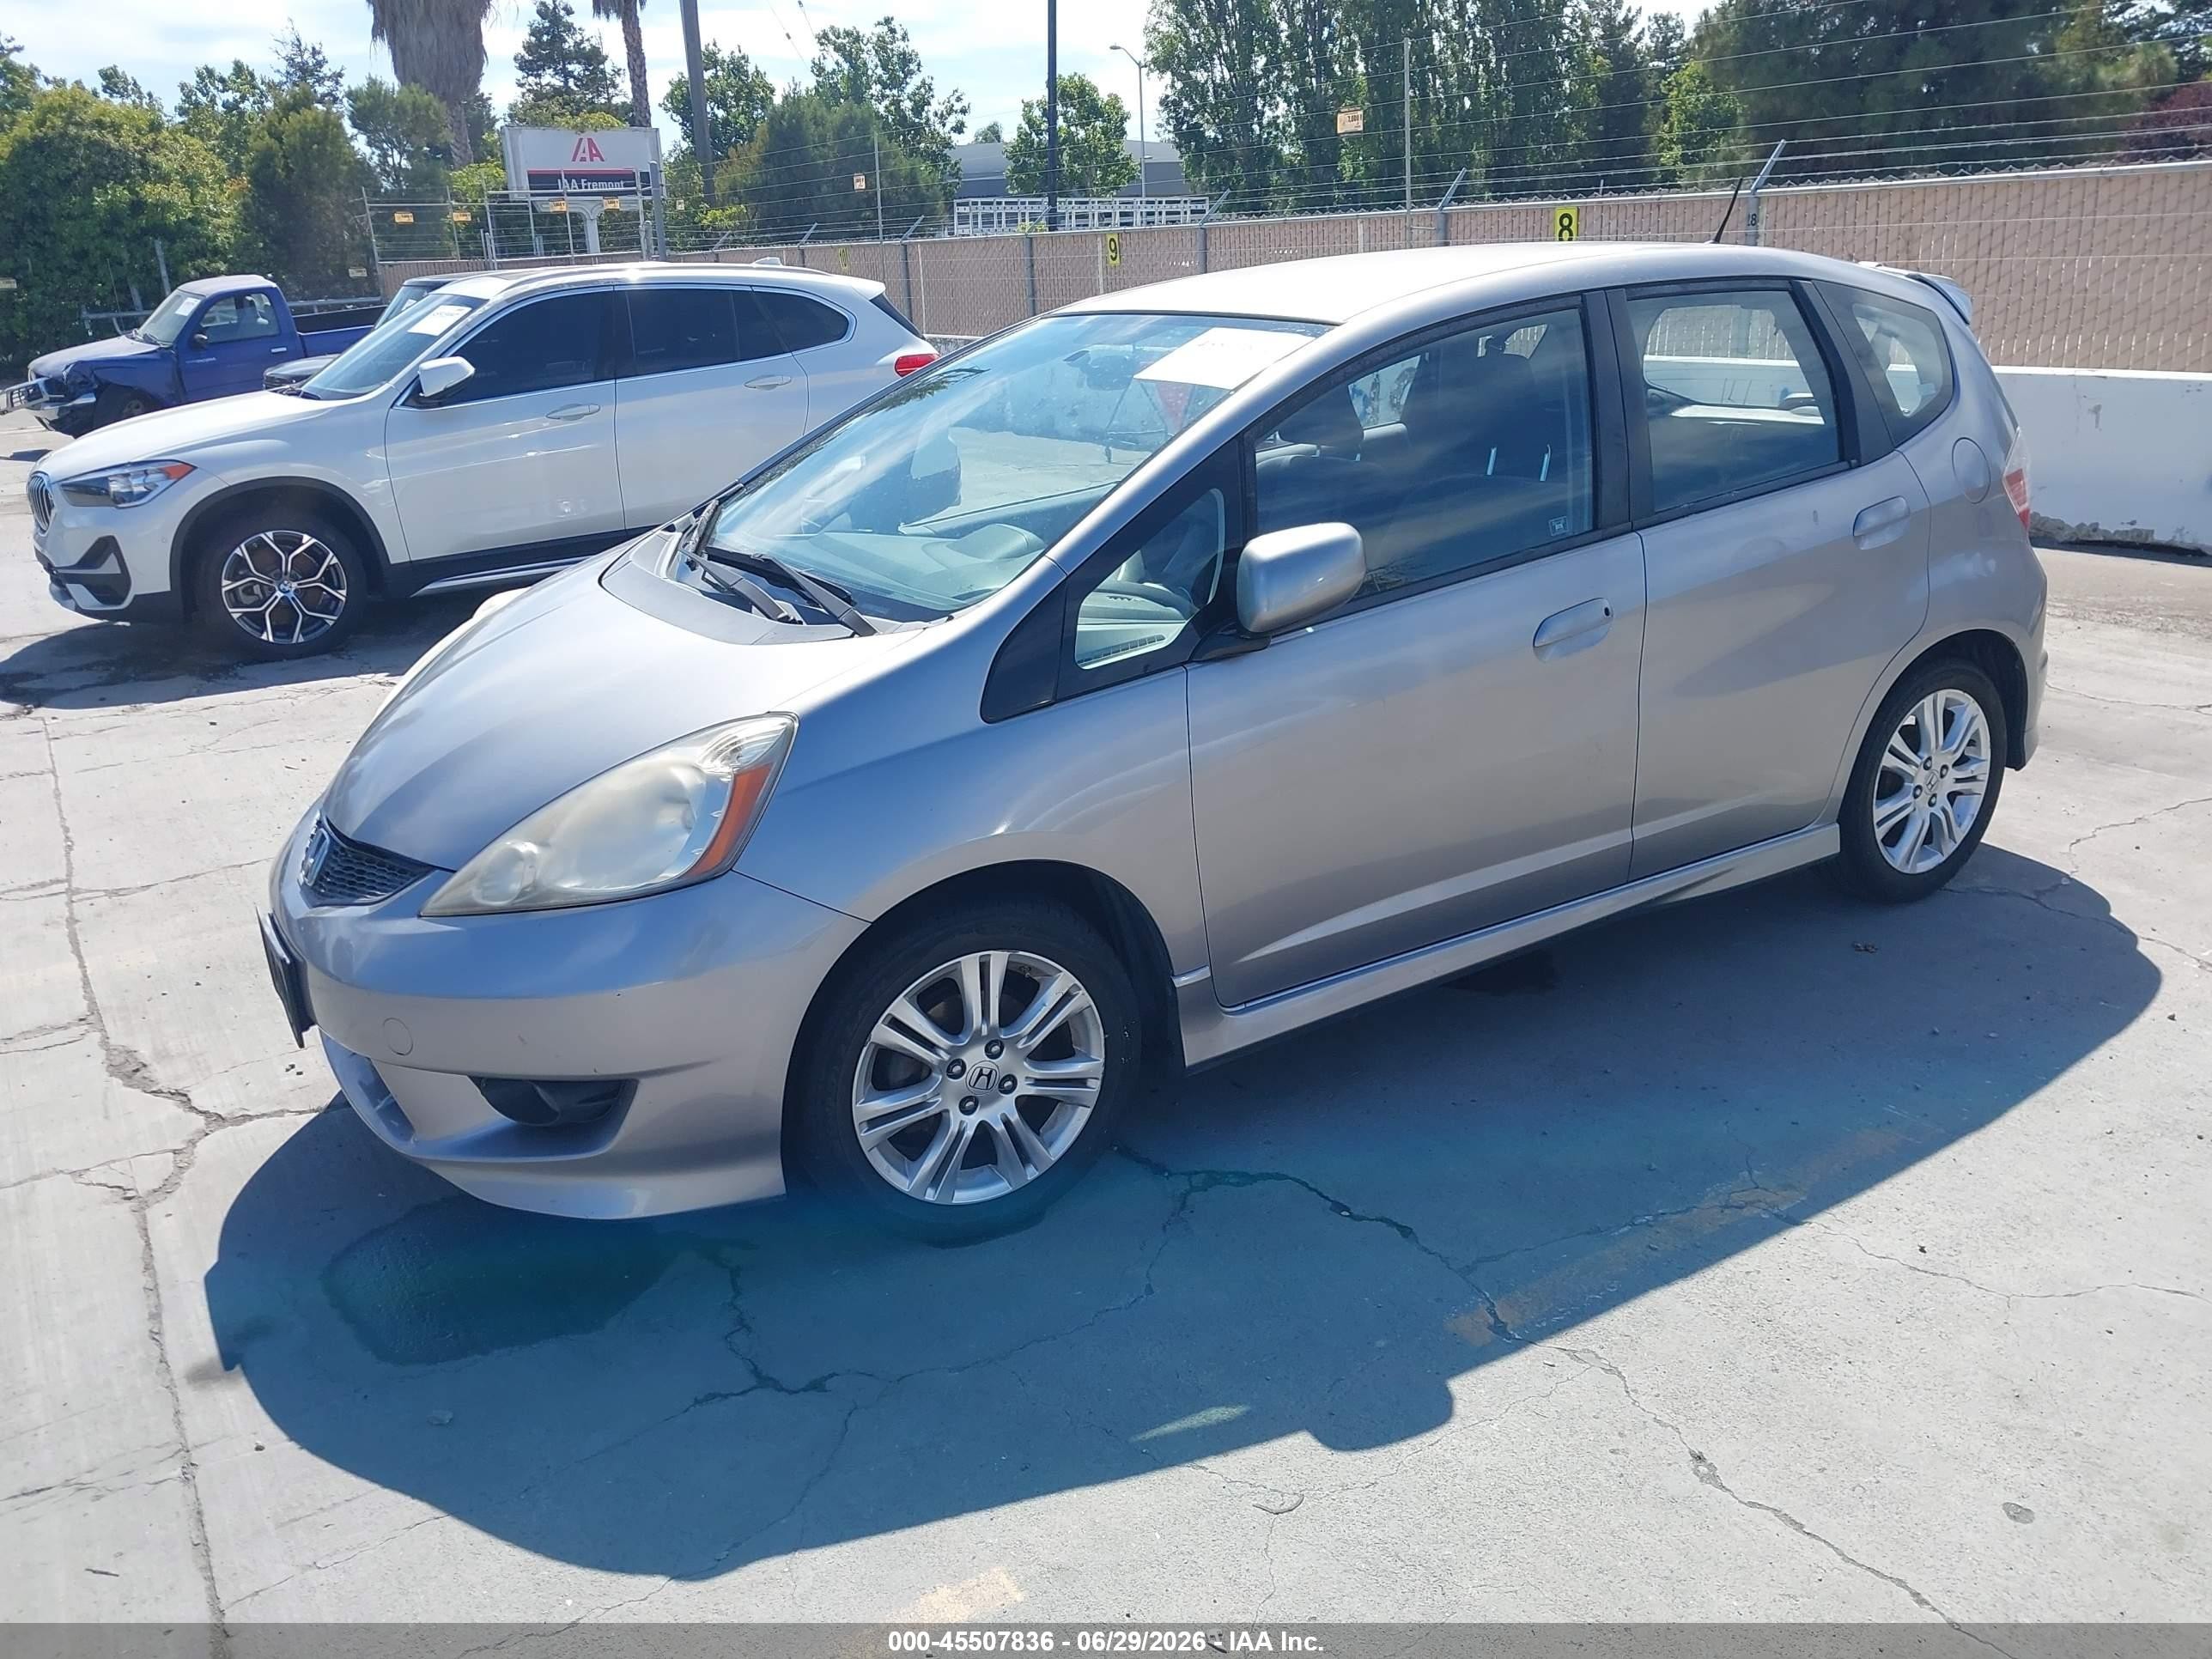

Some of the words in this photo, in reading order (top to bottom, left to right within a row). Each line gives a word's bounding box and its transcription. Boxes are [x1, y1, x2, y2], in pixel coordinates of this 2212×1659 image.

[557, 179, 579, 190] IAA
[581, 179, 624, 190] Fremont
[1558, 212, 1574, 241] 8
[1109, 237, 1118, 261] 9
